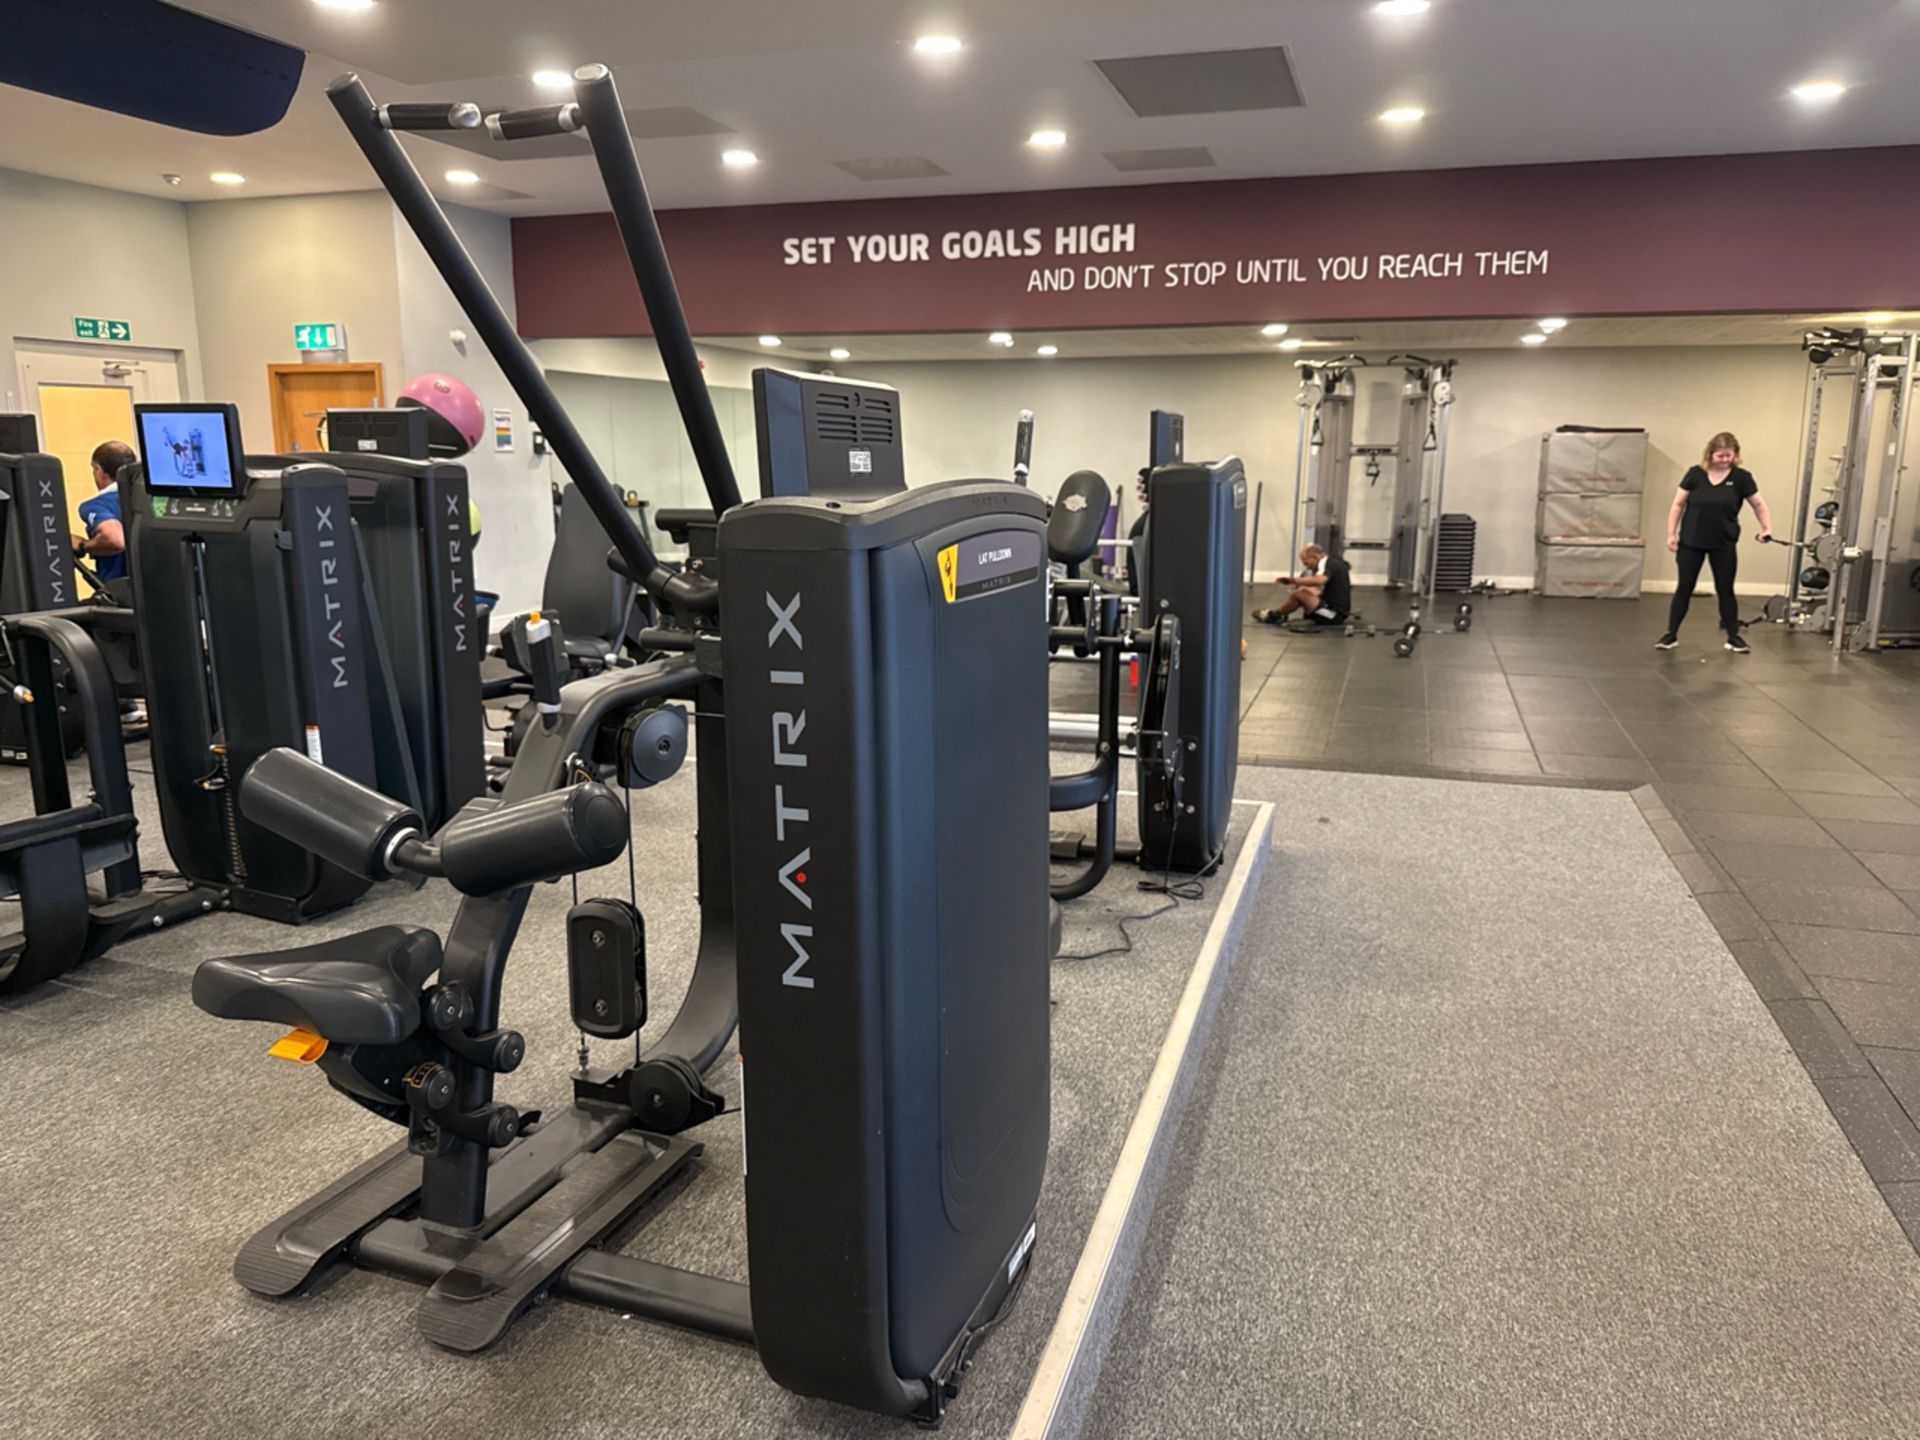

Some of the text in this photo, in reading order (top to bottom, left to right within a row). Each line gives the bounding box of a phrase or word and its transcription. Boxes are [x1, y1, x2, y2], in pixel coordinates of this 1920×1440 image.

[783, 223, 1136, 265] SET YOUR GOALS HIGH
[1026, 249, 1549, 292] AND DON'T STOP UNTIL YOU REACH THEM
[39, 480, 65, 602] MATRIX
[315, 504, 348, 688] MATRIX
[446, 494, 467, 651] MATRIX
[766, 590, 815, 989] MATRIX
